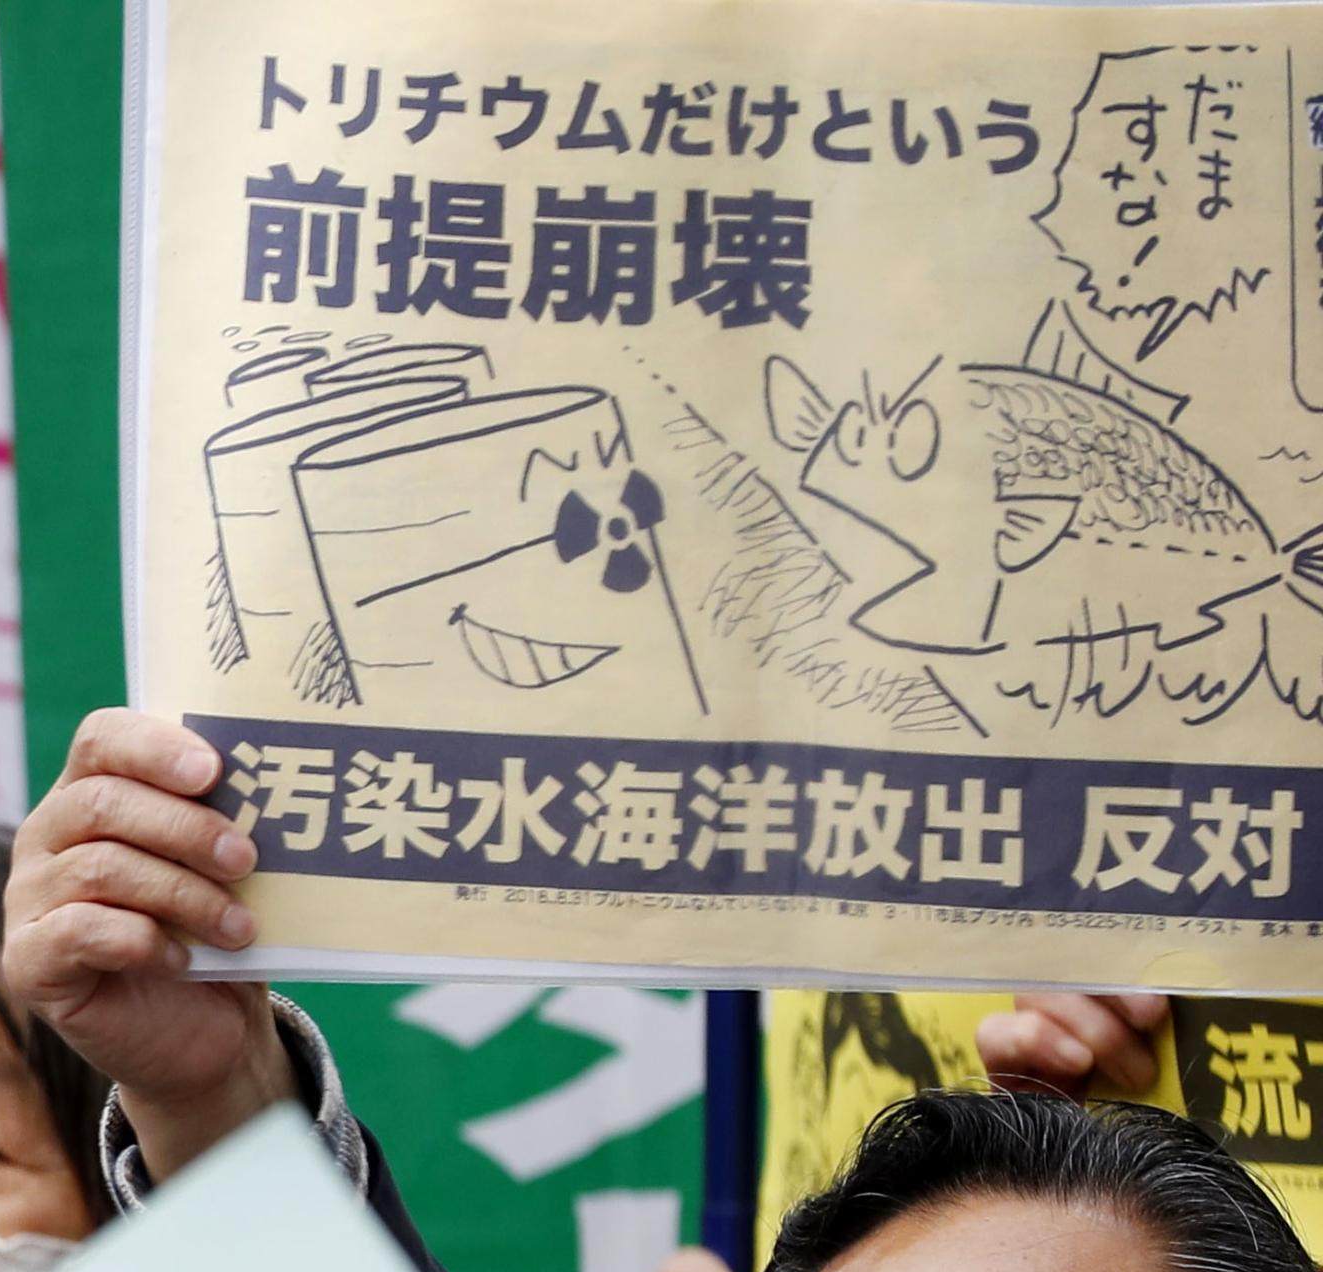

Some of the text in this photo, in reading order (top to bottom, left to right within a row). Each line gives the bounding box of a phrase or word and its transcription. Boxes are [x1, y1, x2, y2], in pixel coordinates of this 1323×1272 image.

[259, 56, 1039, 174] トリチウムだけという
[243, 163, 813, 330] 前提崩壊
[227, 740, 1304, 898] 汚染水海洋放出 反対
[1206, 1023, 1323, 1140] 流
